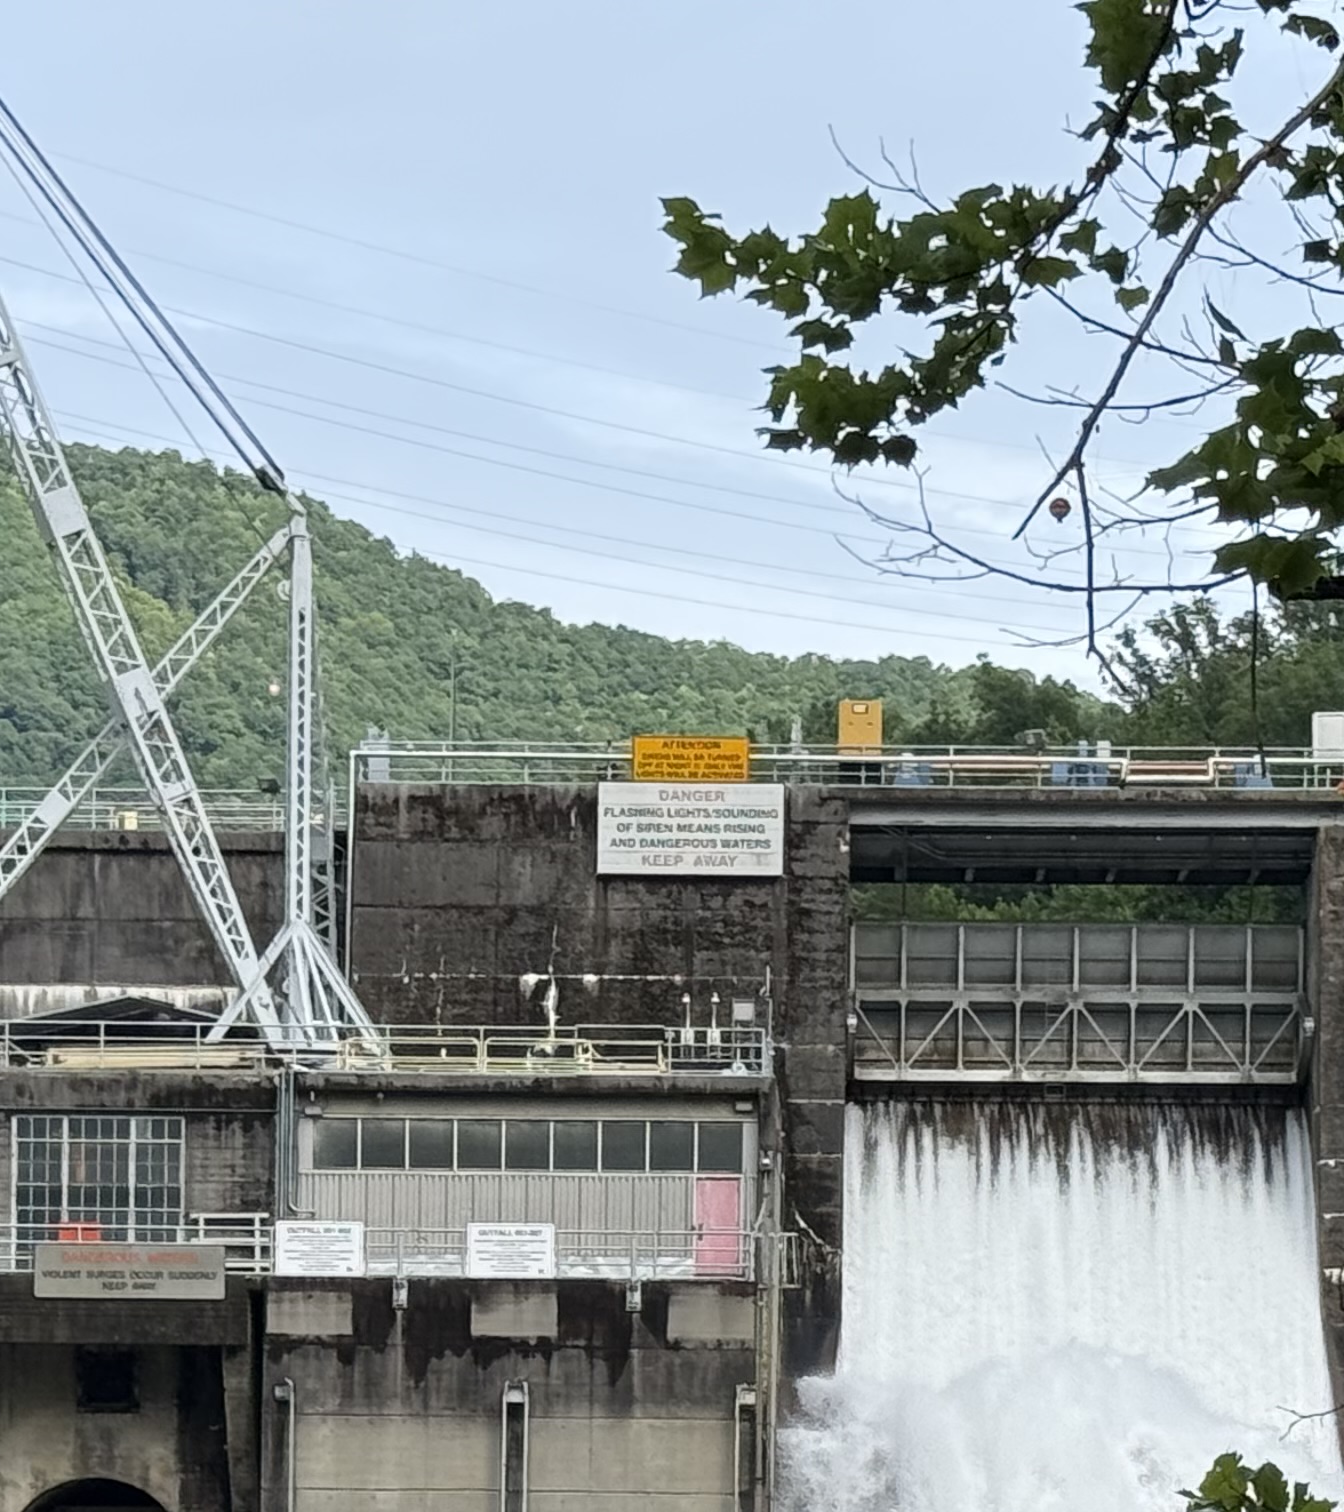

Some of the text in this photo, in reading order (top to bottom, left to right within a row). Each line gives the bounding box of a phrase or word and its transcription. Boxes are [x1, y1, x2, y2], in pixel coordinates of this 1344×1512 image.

[662, 740, 722, 750] ATTENTION
[658, 789, 725, 802] DANGER
[603, 807, 665, 818] FLASHING
[617, 823, 766, 834] OF SIREN MEANS RISING
[610, 838, 771, 849] AND DANGEROUS WATERS
[641, 854, 738, 867] KEEP AWAY
[41, 1270, 81, 1279] VIOLENT
[86, 1270, 126, 1280] SURGES
[129, 1270, 164, 1280] OCCUR
